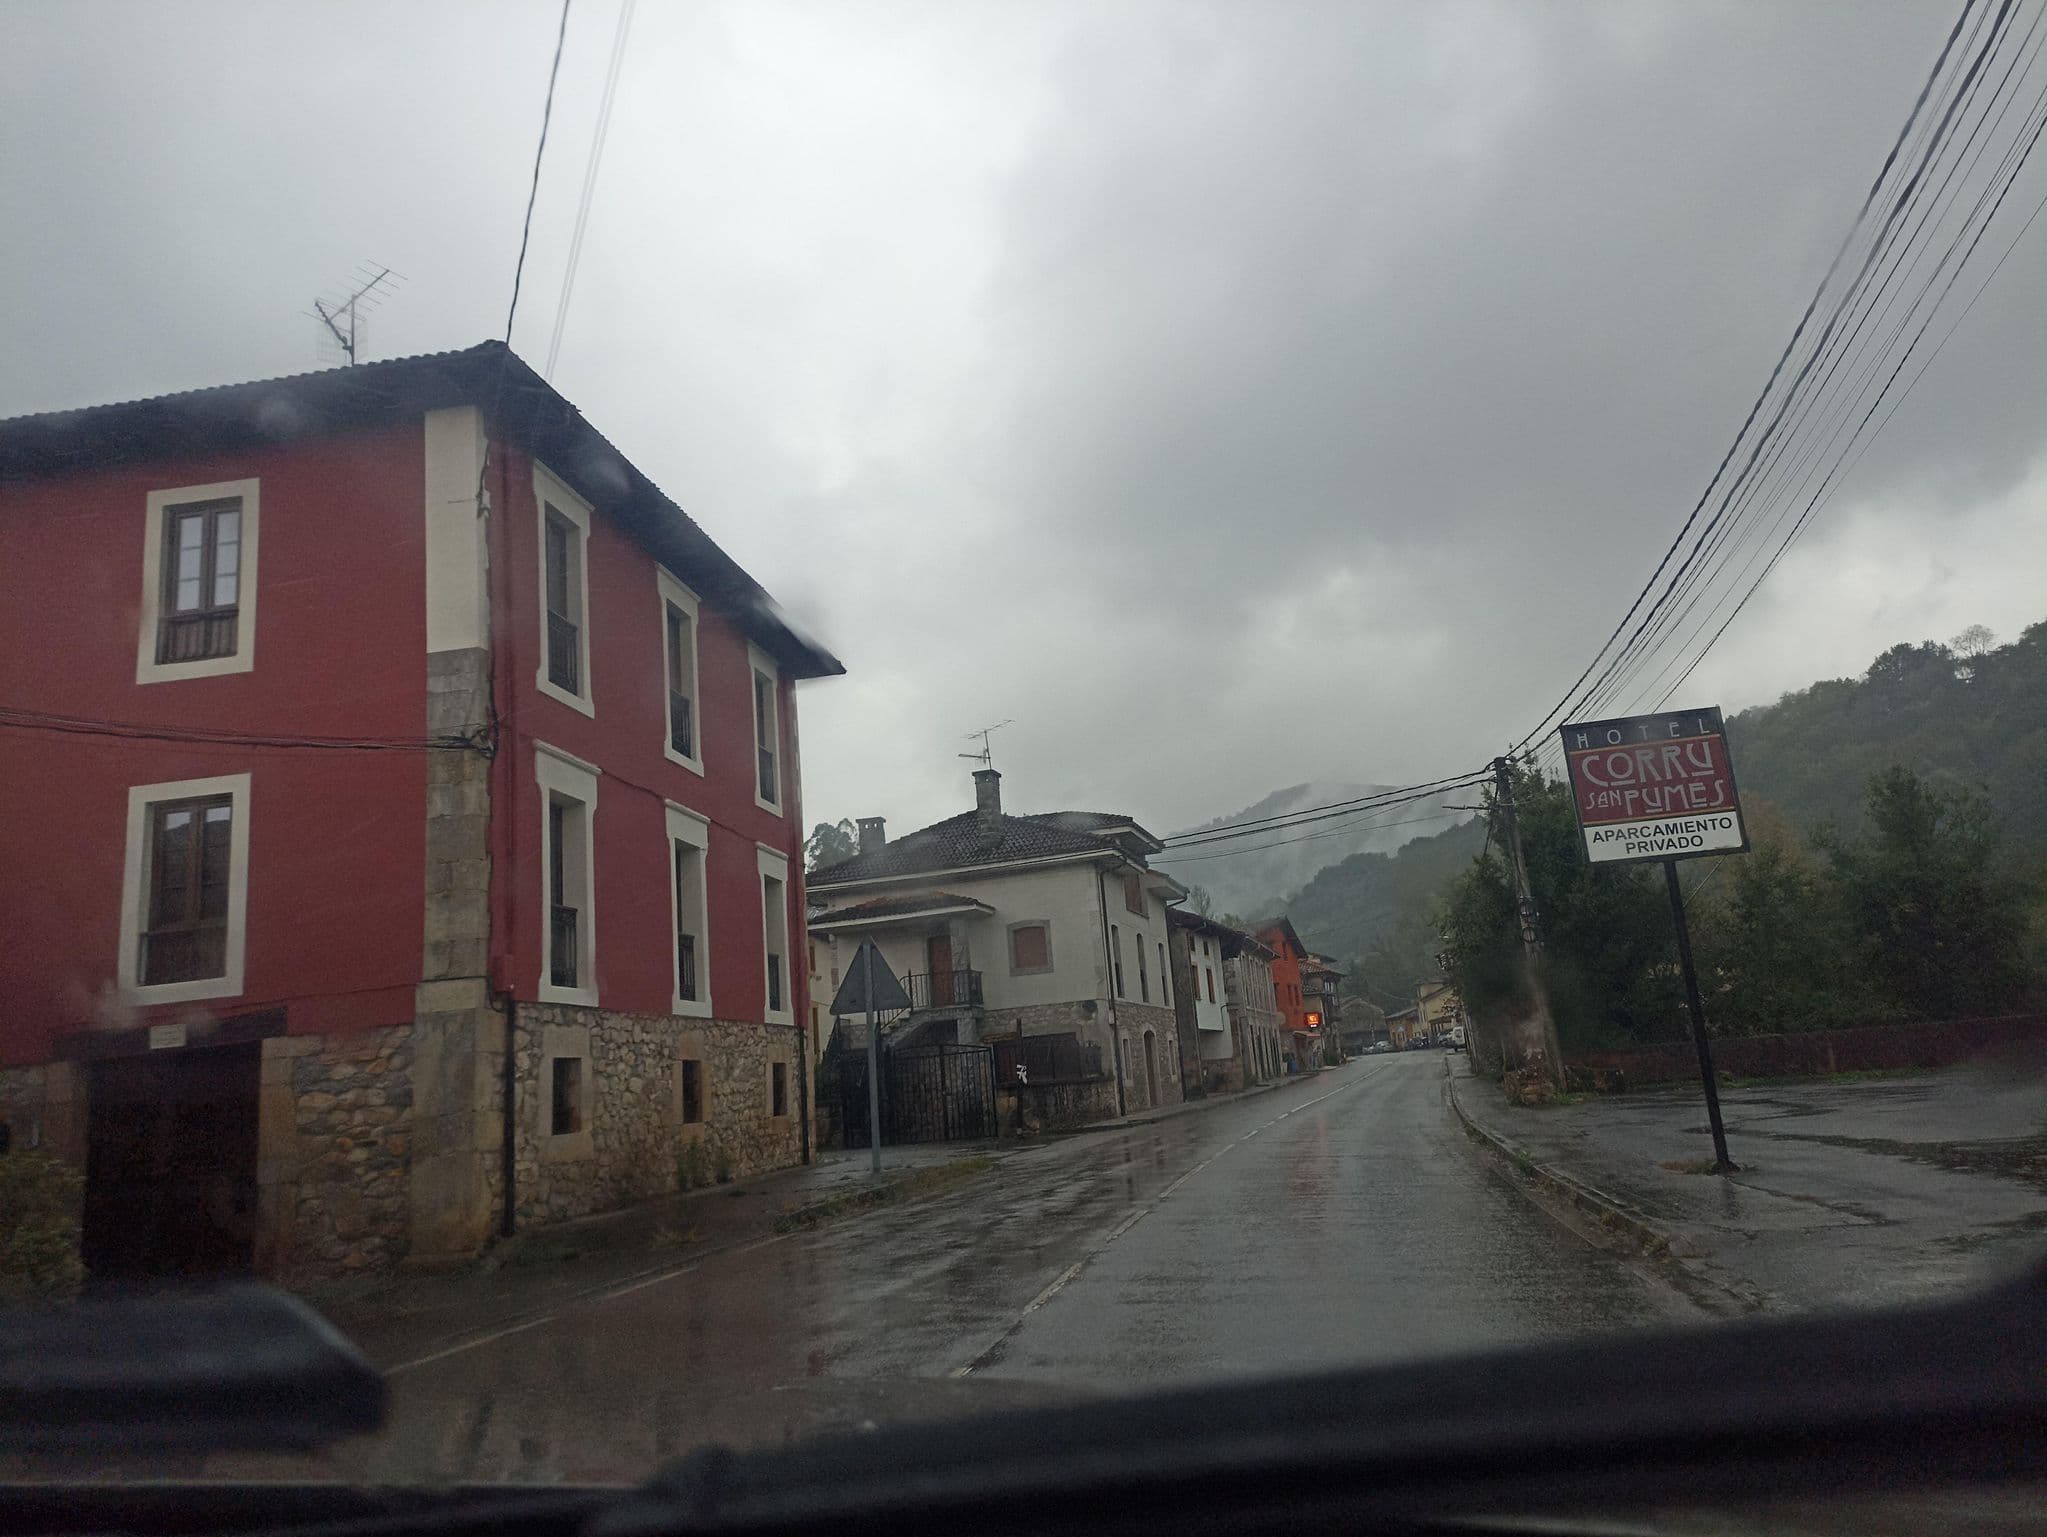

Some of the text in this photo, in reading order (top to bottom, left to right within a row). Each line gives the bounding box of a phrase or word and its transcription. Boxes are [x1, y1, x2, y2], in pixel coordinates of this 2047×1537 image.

[1576, 718, 1710, 749] HOTEL
[1581, 741, 1715, 787] CORRU
[1586, 779, 1724, 816] SAN PUMES
[1592, 817, 1733, 844] APARCAMIENTO
[1625, 835, 1704, 855] PRIVADO
